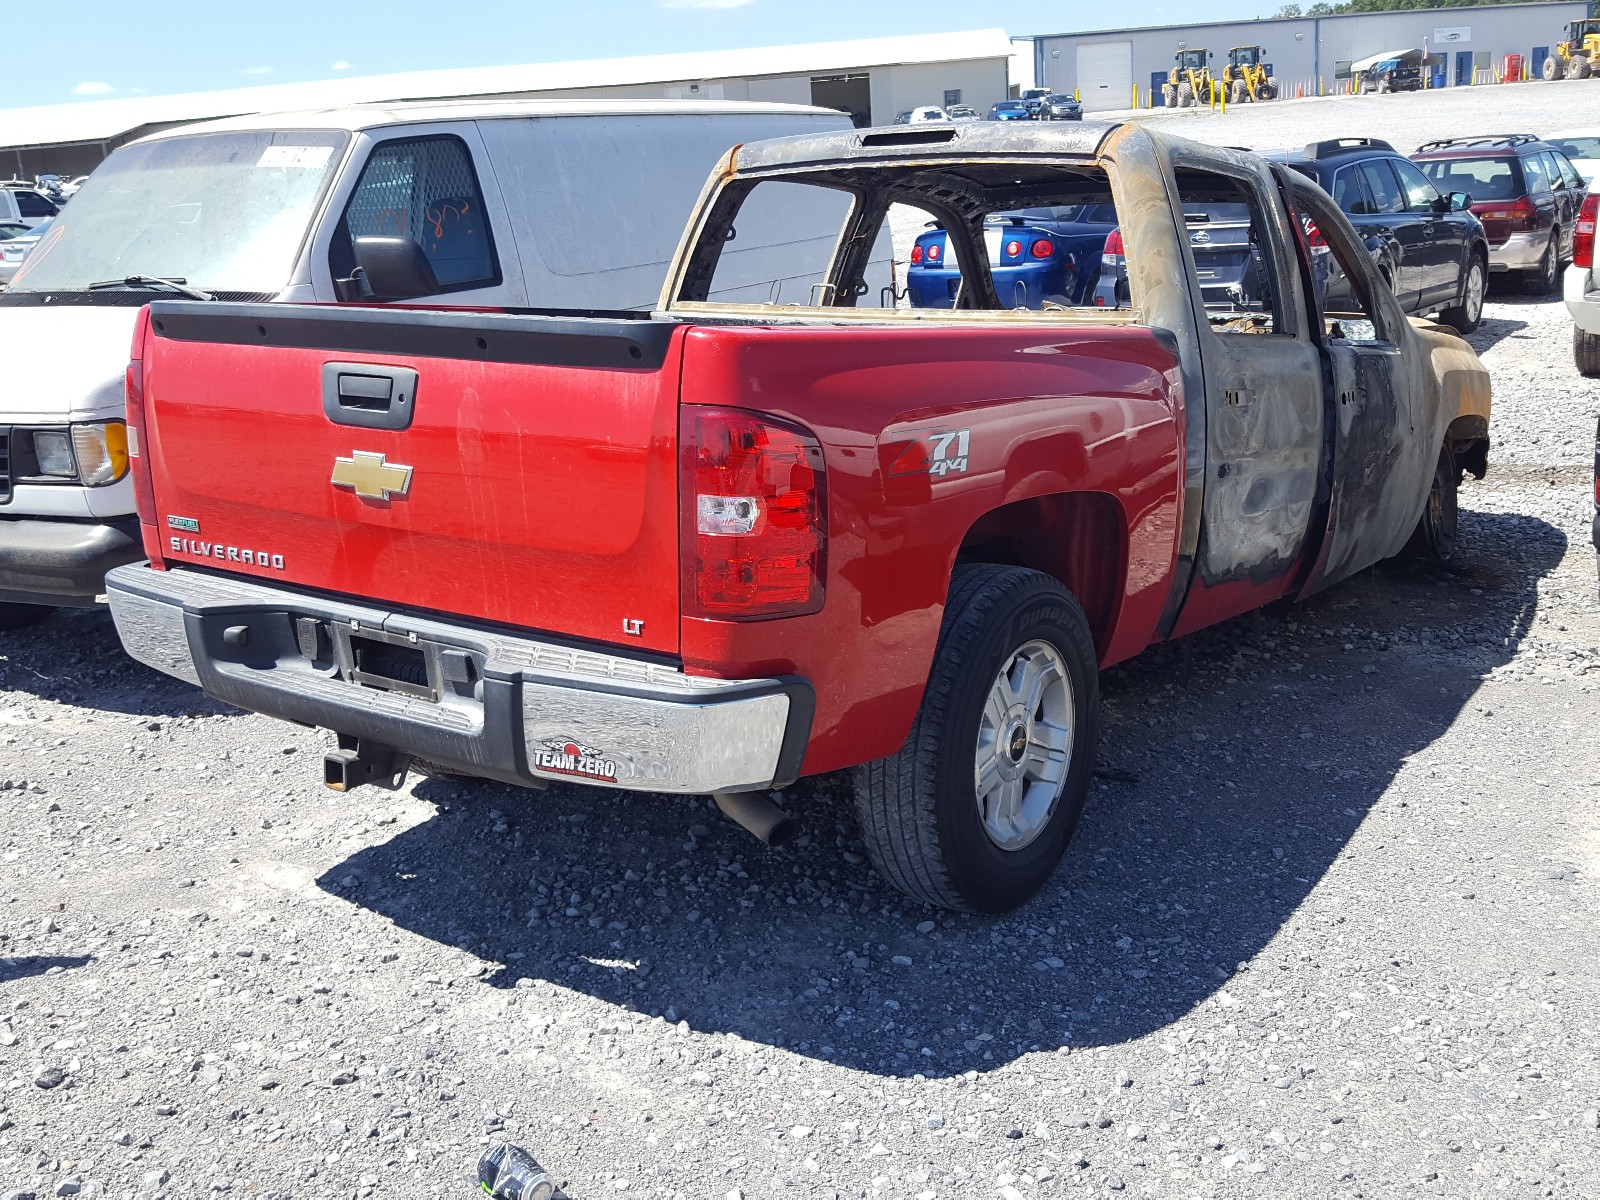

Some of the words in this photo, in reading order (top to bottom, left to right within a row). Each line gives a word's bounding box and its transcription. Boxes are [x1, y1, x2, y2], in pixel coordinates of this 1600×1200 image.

[170, 537, 285, 569] SILVERADO
[623, 618, 644, 635] LT
[534, 749, 575, 770] TEAM
[578, 756, 616, 777] ZERO
